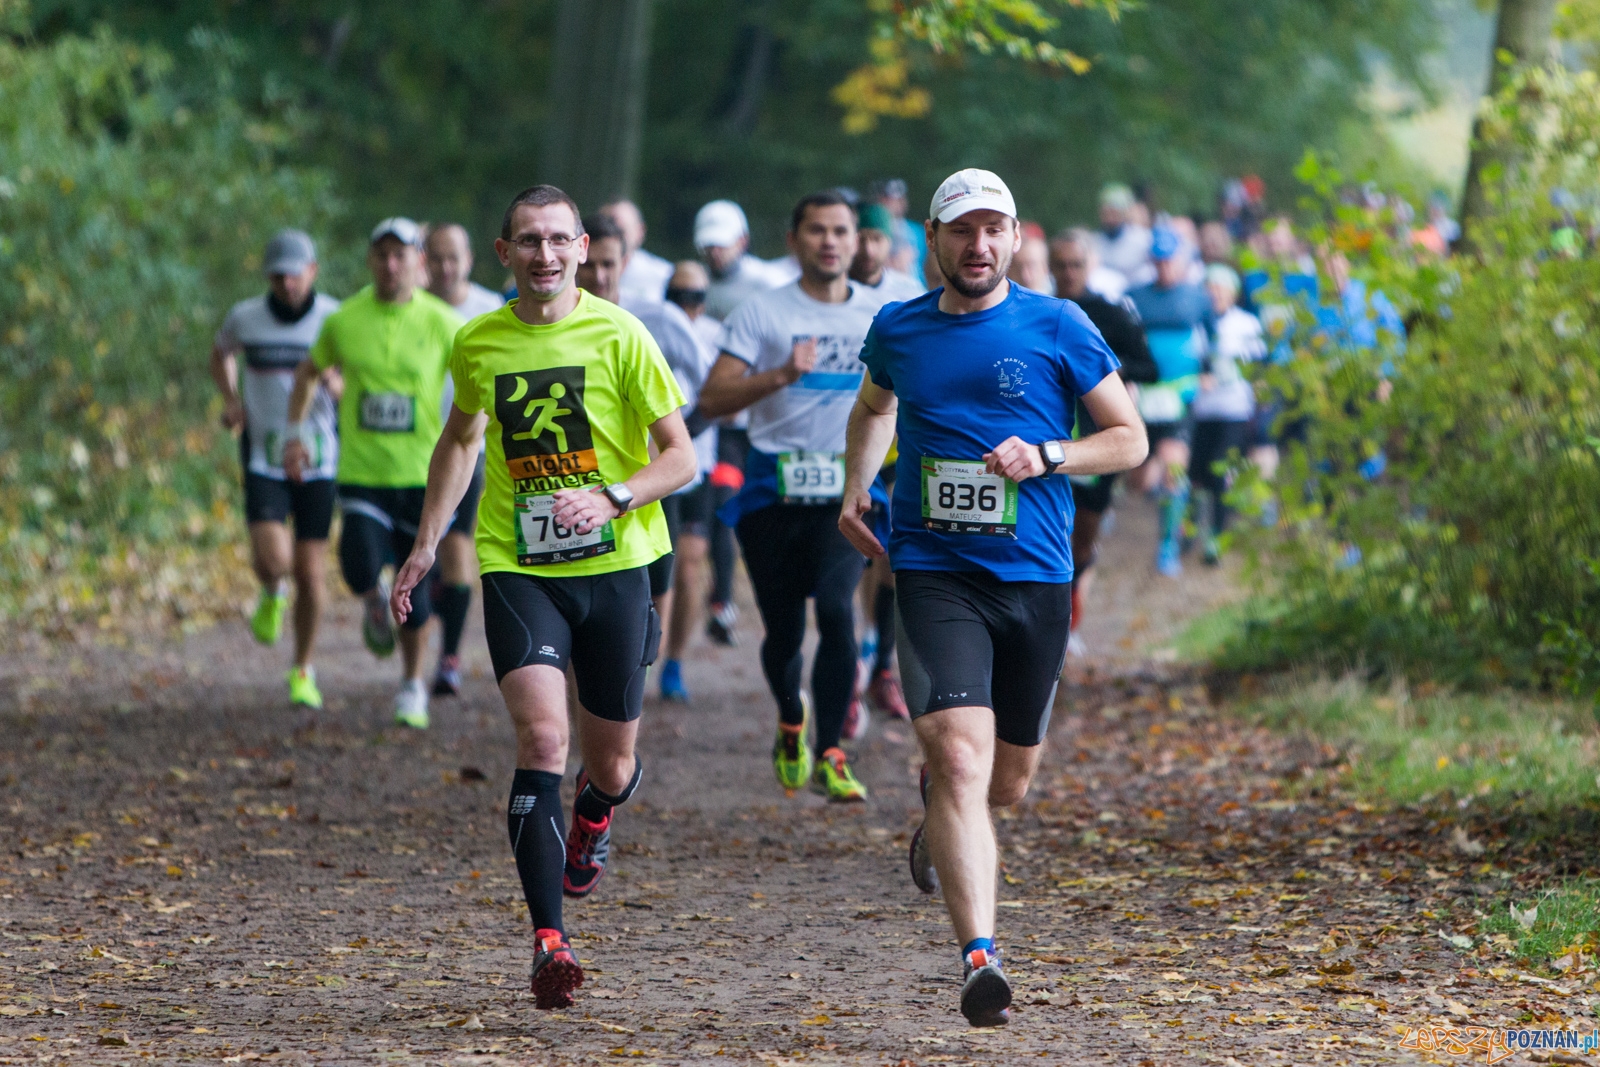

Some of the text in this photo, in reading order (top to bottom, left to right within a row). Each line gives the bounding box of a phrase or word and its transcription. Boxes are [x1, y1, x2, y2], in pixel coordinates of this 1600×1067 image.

[523, 453, 581, 475] night
[515, 471, 602, 493] runners
[794, 467, 835, 487] 933
[939, 482, 996, 511] 836
[949, 513, 982, 521] MATEUSZ
